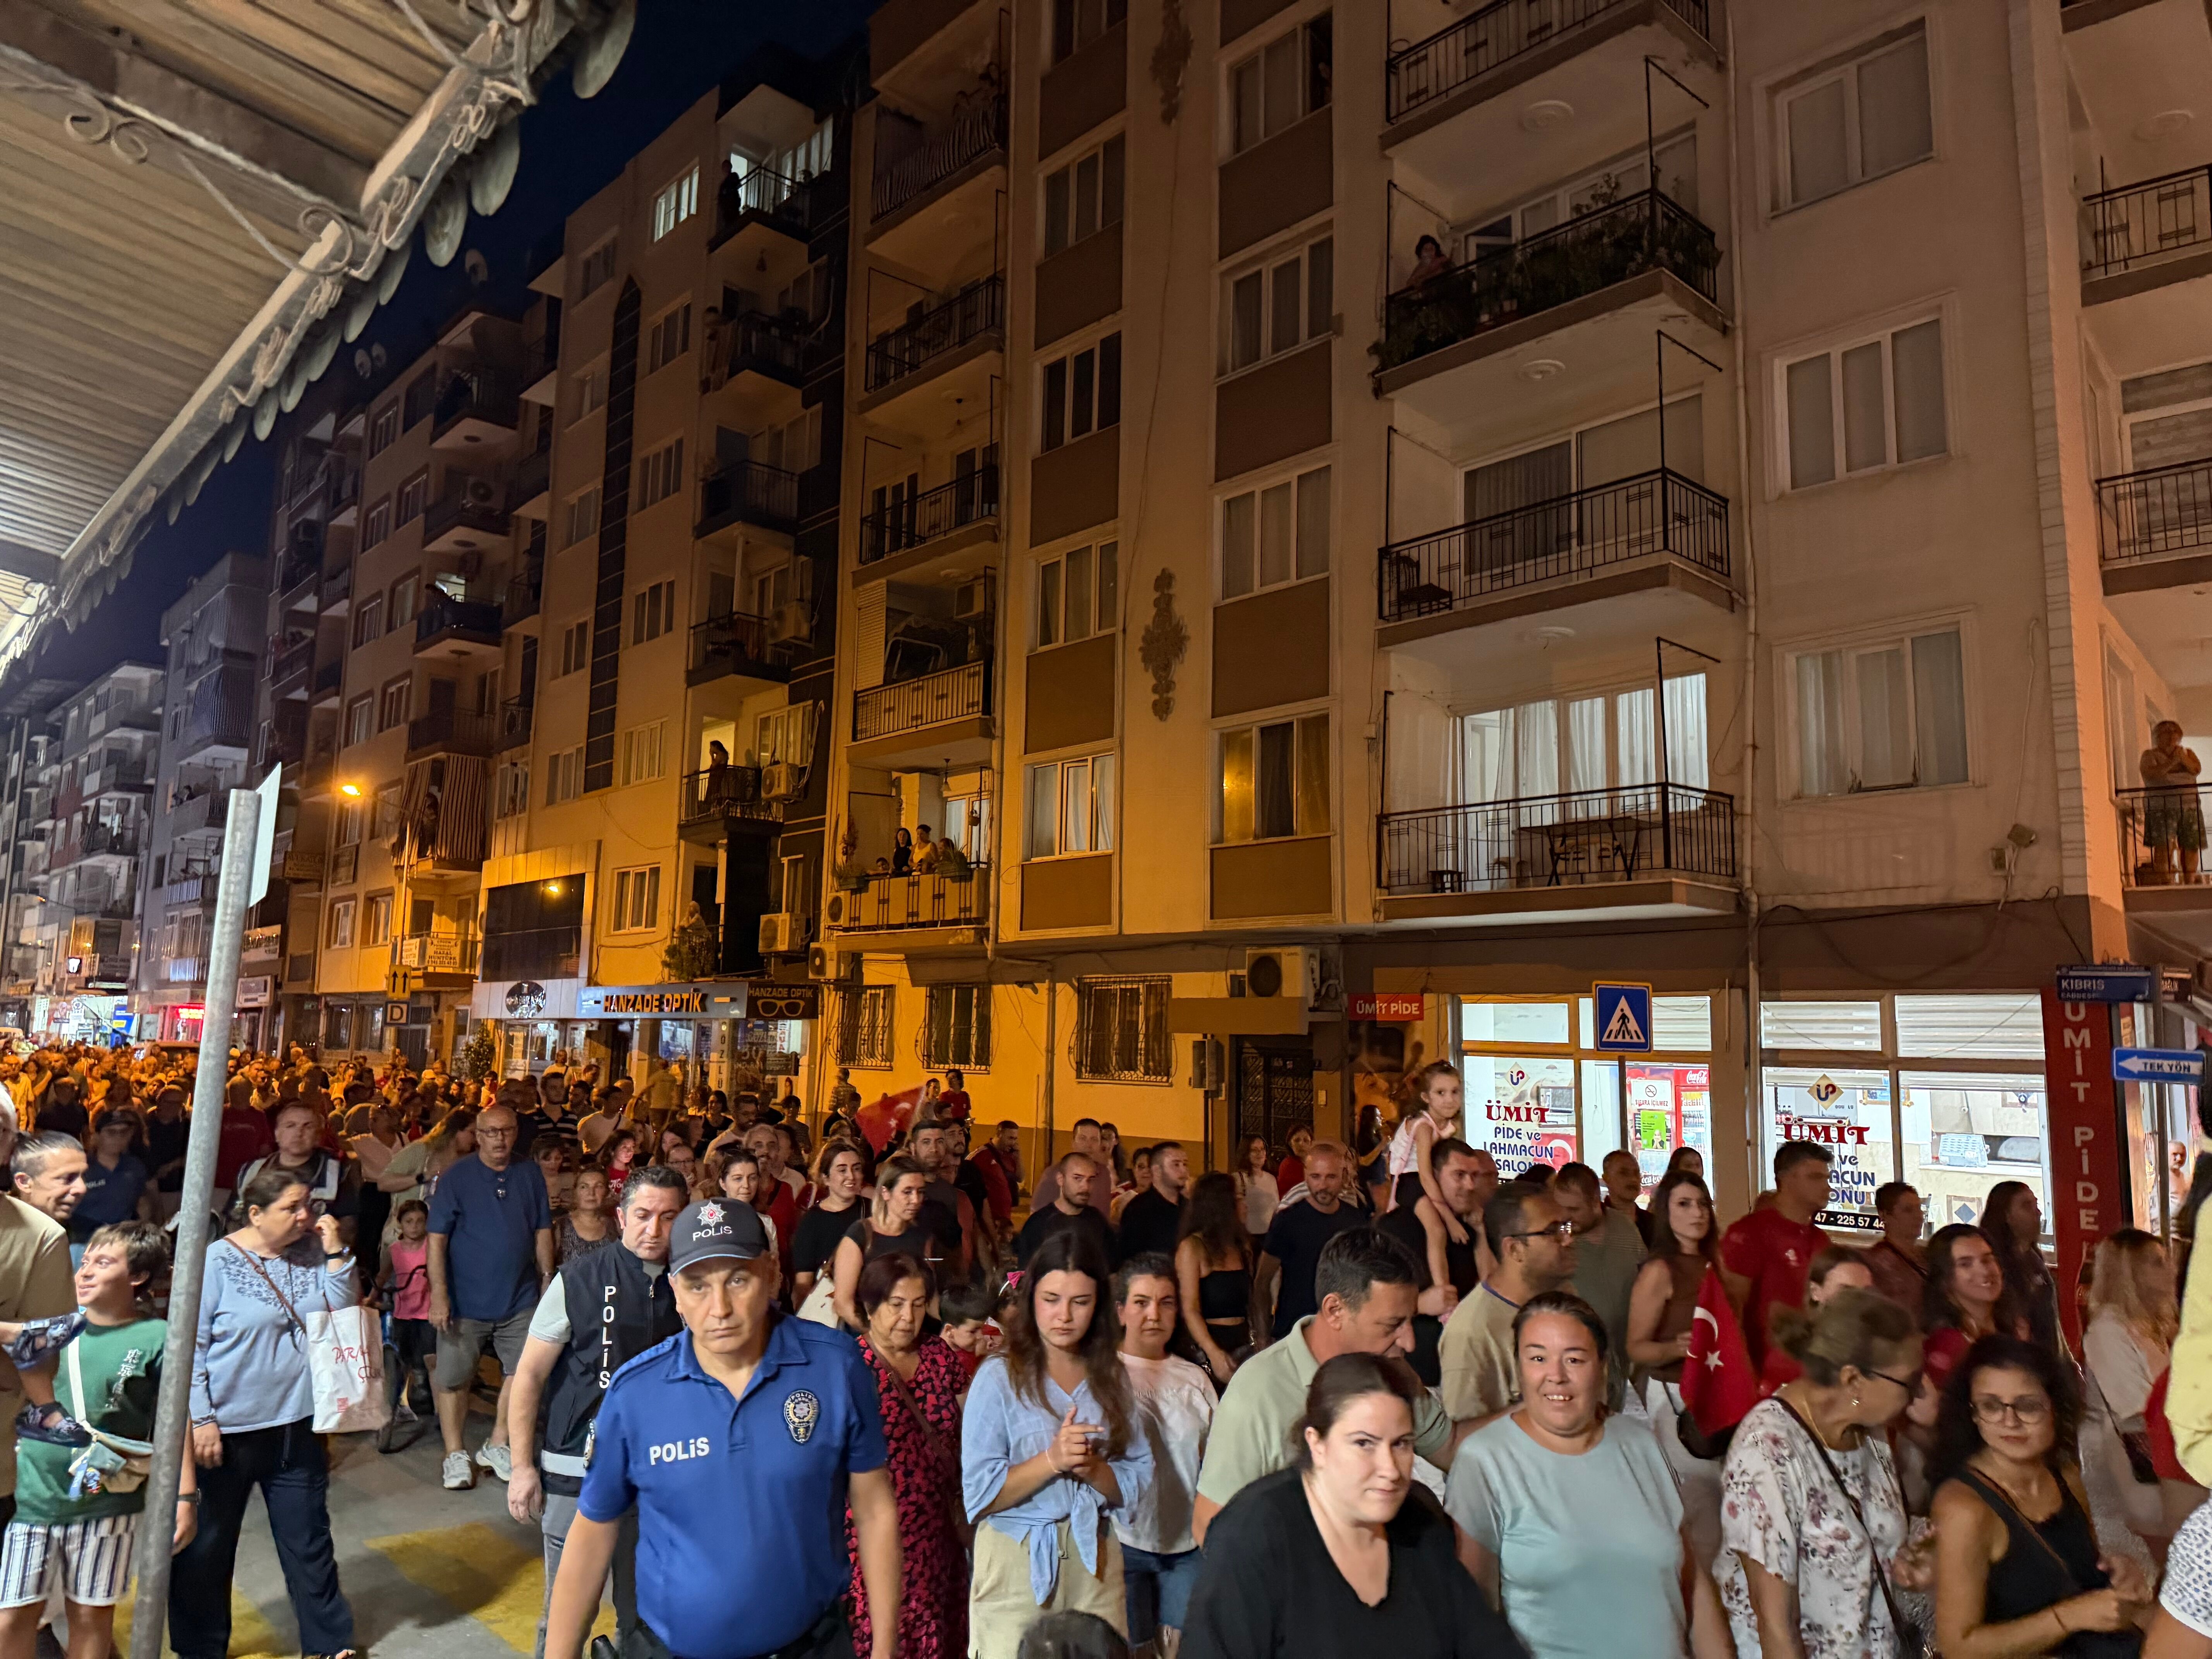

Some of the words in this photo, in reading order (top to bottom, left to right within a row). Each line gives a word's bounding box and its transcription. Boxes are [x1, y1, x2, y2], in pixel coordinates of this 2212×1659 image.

[749, 988, 788, 997] HANZADE
[791, 986, 813, 998] OPTİK
[2061, 979, 2105, 991] KIBRIS
[603, 994, 659, 1012] HANZADE
[663, 988, 701, 1012] OPTİK
[1357, 1000, 1387, 1014] ÜMİT
[1391, 1000, 1420, 1014] PİDE
[390, 1005, 404, 1021] D
[2142, 1062, 2164, 1072] TEK
[2168, 1061, 2191, 1073] YÖN
[1485, 1099, 1549, 1123] ÜMİT
[1494, 1123, 1522, 1140] PİDE
[1526, 1132, 1541, 1141] ve
[1783, 1116, 1870, 1145] ÜMİT
[1484, 1141, 1553, 1159] LAHMACUN
[1838, 1154, 1859, 1166] ve
[2073, 1126, 2099, 1231] PİDE
[1837, 1214, 1855, 1225] 225
[1858, 1217, 1870, 1227] 57
[599, 1286, 616, 1389] POLİS
[649, 1437, 709, 1465] POLİS
